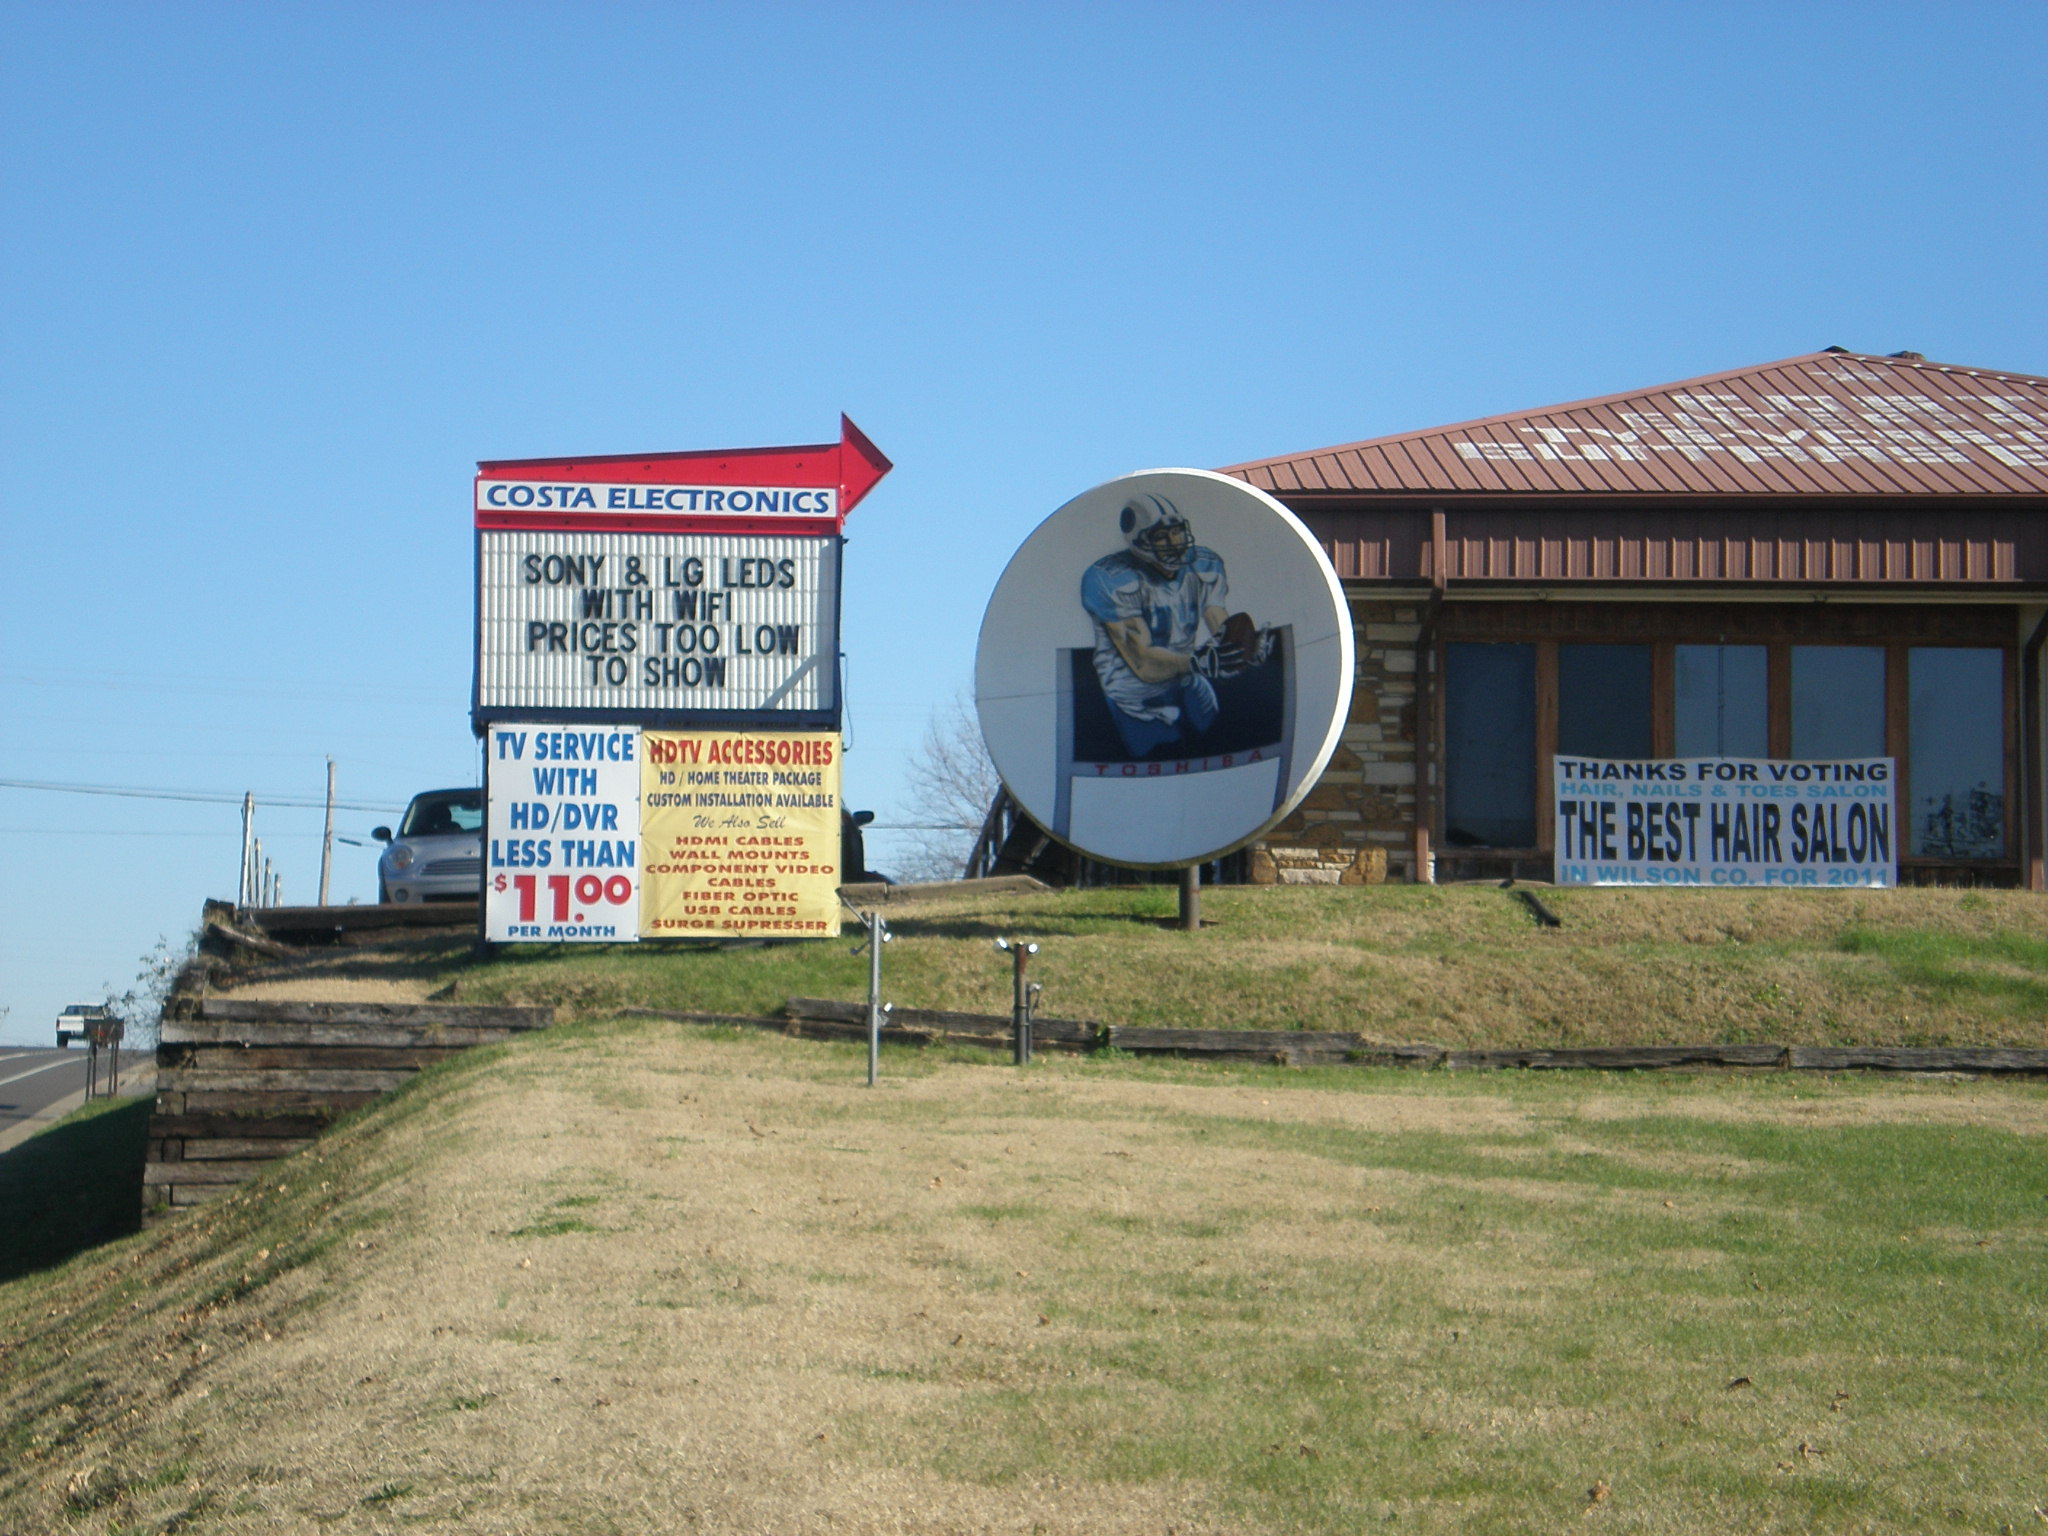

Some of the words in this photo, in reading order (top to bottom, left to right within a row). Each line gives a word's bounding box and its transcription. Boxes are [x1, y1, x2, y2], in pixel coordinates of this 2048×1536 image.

[487, 485, 596, 508] COSTA
[608, 487, 830, 514] ELECTRONICS
[524, 555, 604, 585] SONY
[626, 556, 648, 585] &
[666, 557, 703, 587] LG
[723, 558, 795, 589] LEDS
[580, 589, 653, 620] WITH
[675, 591, 732, 622] WIFI
[528, 622, 637, 653] PRICES
[655, 624, 720, 654] TOO
[737, 625, 800, 656] LOW
[587, 655, 627, 686] TO
[644, 657, 726, 688] SHOW
[496, 732, 526, 760] TV
[535, 732, 634, 761] SERVICE
[650, 740, 702, 764] HDTV
[707, 740, 833, 765] ACCESSORIES
[1095, 749, 1262, 777] TOSHIBA
[1559, 761, 1686, 780] THANKS
[1698, 763, 1759, 780] FOR
[1768, 764, 1887, 781] VOTING
[533, 768, 597, 796] WITH
[660, 771, 675, 784] HD
[688, 771, 719, 785] HOME
[724, 772, 768, 785] THEATER
[773, 772, 821, 785] PACKAGE
[1561, 782, 1624, 798] HAIR,
[1632, 783, 1702, 797] NAILS
[1711, 783, 1727, 797] &
[1735, 784, 1798, 797] TOES
[1807, 784, 1887, 798] SALON
[647, 793, 692, 807] CUSTOM
[695, 793, 772, 807] INSTALLATION
[776, 794, 834, 808] AVAILABLE
[511, 802, 618, 833] HD/DVR
[693, 815, 714, 828] We
[719, 815, 750, 829] Also
[757, 815, 786, 829] Sell
[676, 836, 728, 846] HDMI
[736, 837, 804, 846] CABLES
[1559, 800, 1617, 860] THE
[1627, 801, 1701, 863] BEST
[1711, 802, 1782, 863] HAIR
[1791, 802, 1890, 864] SALON
[491, 840, 551, 867] LESS
[561, 840, 635, 868] THAN
[669, 850, 720, 859] WALL
[727, 850, 810, 860] MOUNTS
[645, 864, 768, 874] COMPONENT
[776, 865, 834, 874] VIDEO
[1562, 865, 1587, 882] IN
[1596, 866, 1700, 885] WILSON
[1710, 867, 1755, 885] CO.
[1765, 868, 1819, 885] FOR
[1827, 868, 1887, 885] 2011
[708, 878, 776, 887] CABLES
[683, 892, 735, 901] FIBER
[743, 892, 799, 901] OPTIC
[684, 906, 721, 914] USB
[728, 906, 796, 915] CABLES
[508, 926, 541, 937] PER
[548, 926, 616, 937] MONTH
[651, 920, 715, 929] SURGE
[721, 920, 827, 930] SUPRESSER
